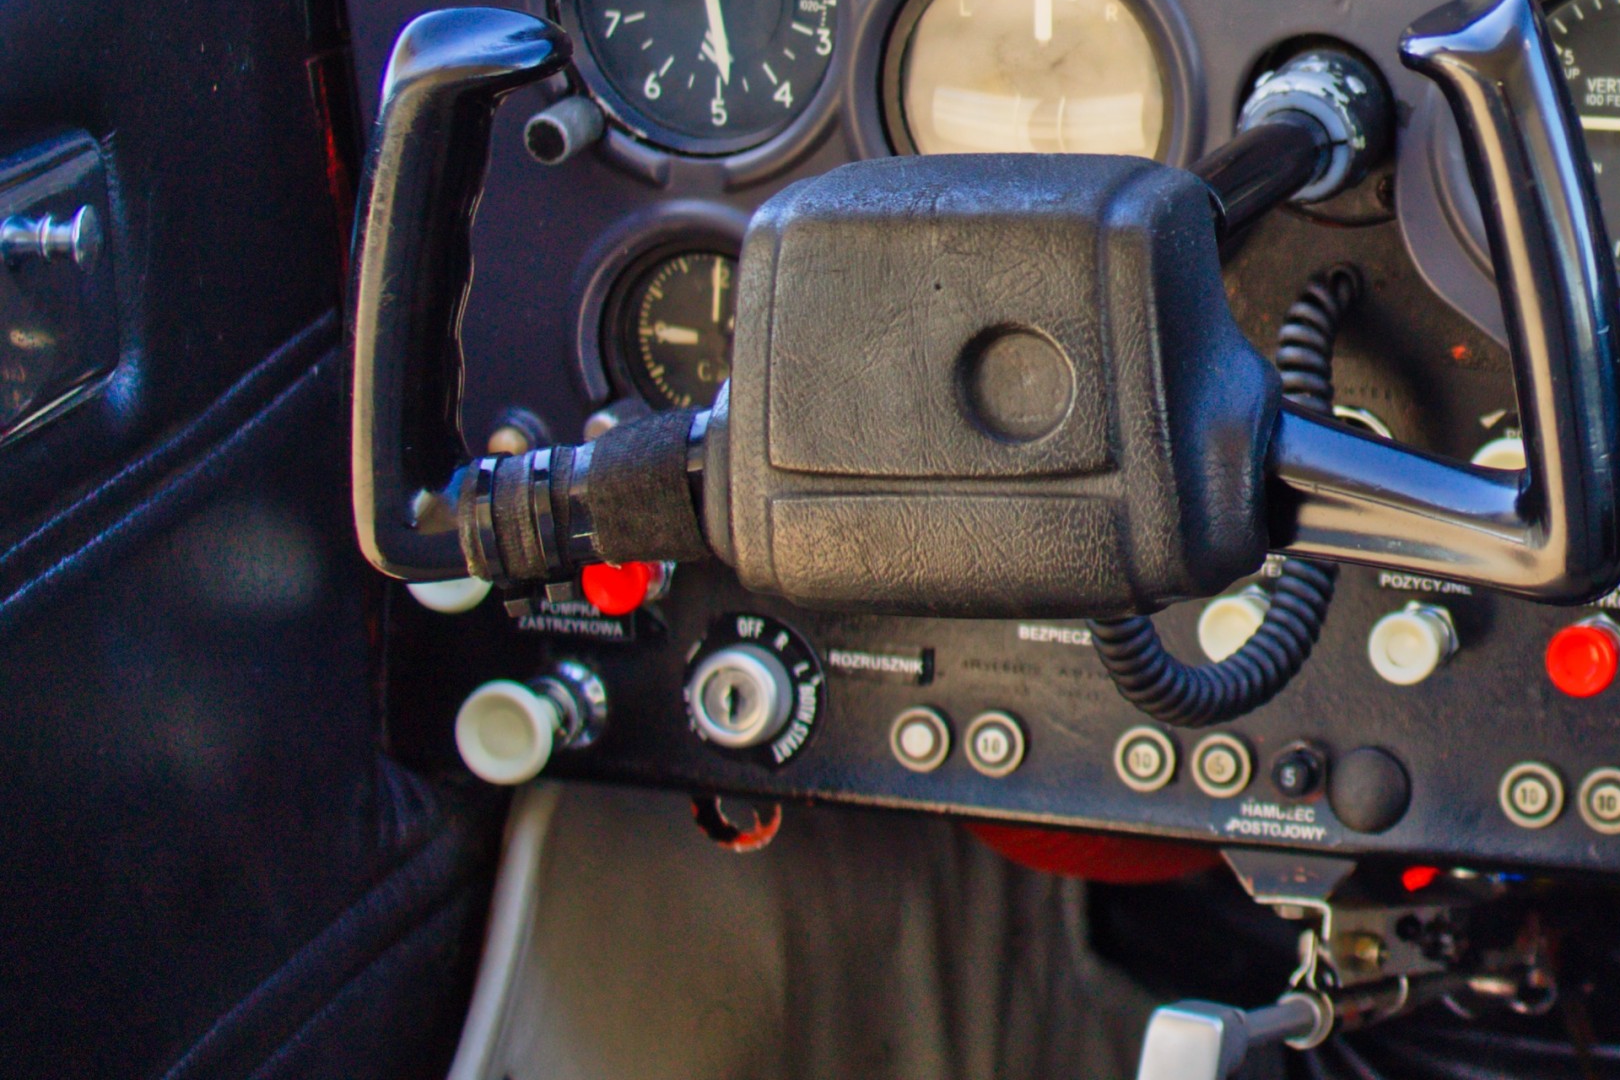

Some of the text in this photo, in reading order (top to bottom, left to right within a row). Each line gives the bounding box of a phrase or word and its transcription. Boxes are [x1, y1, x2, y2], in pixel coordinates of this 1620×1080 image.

[605, 10, 620, 39] 7
[816, 28, 832, 55] 3
[1564, 50, 1574, 65] 5
[644, 72, 661, 99] 6
[773, 81, 793, 108] 4
[1586, 94, 1603, 106] 100
[711, 100, 727, 126] 5
[737, 617, 764, 638] OFF
[774, 631, 789, 651] R
[830, 649, 924, 675] ROZRUSZNIK
[1281, 767, 1296, 787] 5
[1521, 787, 1540, 806] 10
[1599, 795, 1617, 813] 10
[1226, 818, 1326, 841] POSTOJOWY
